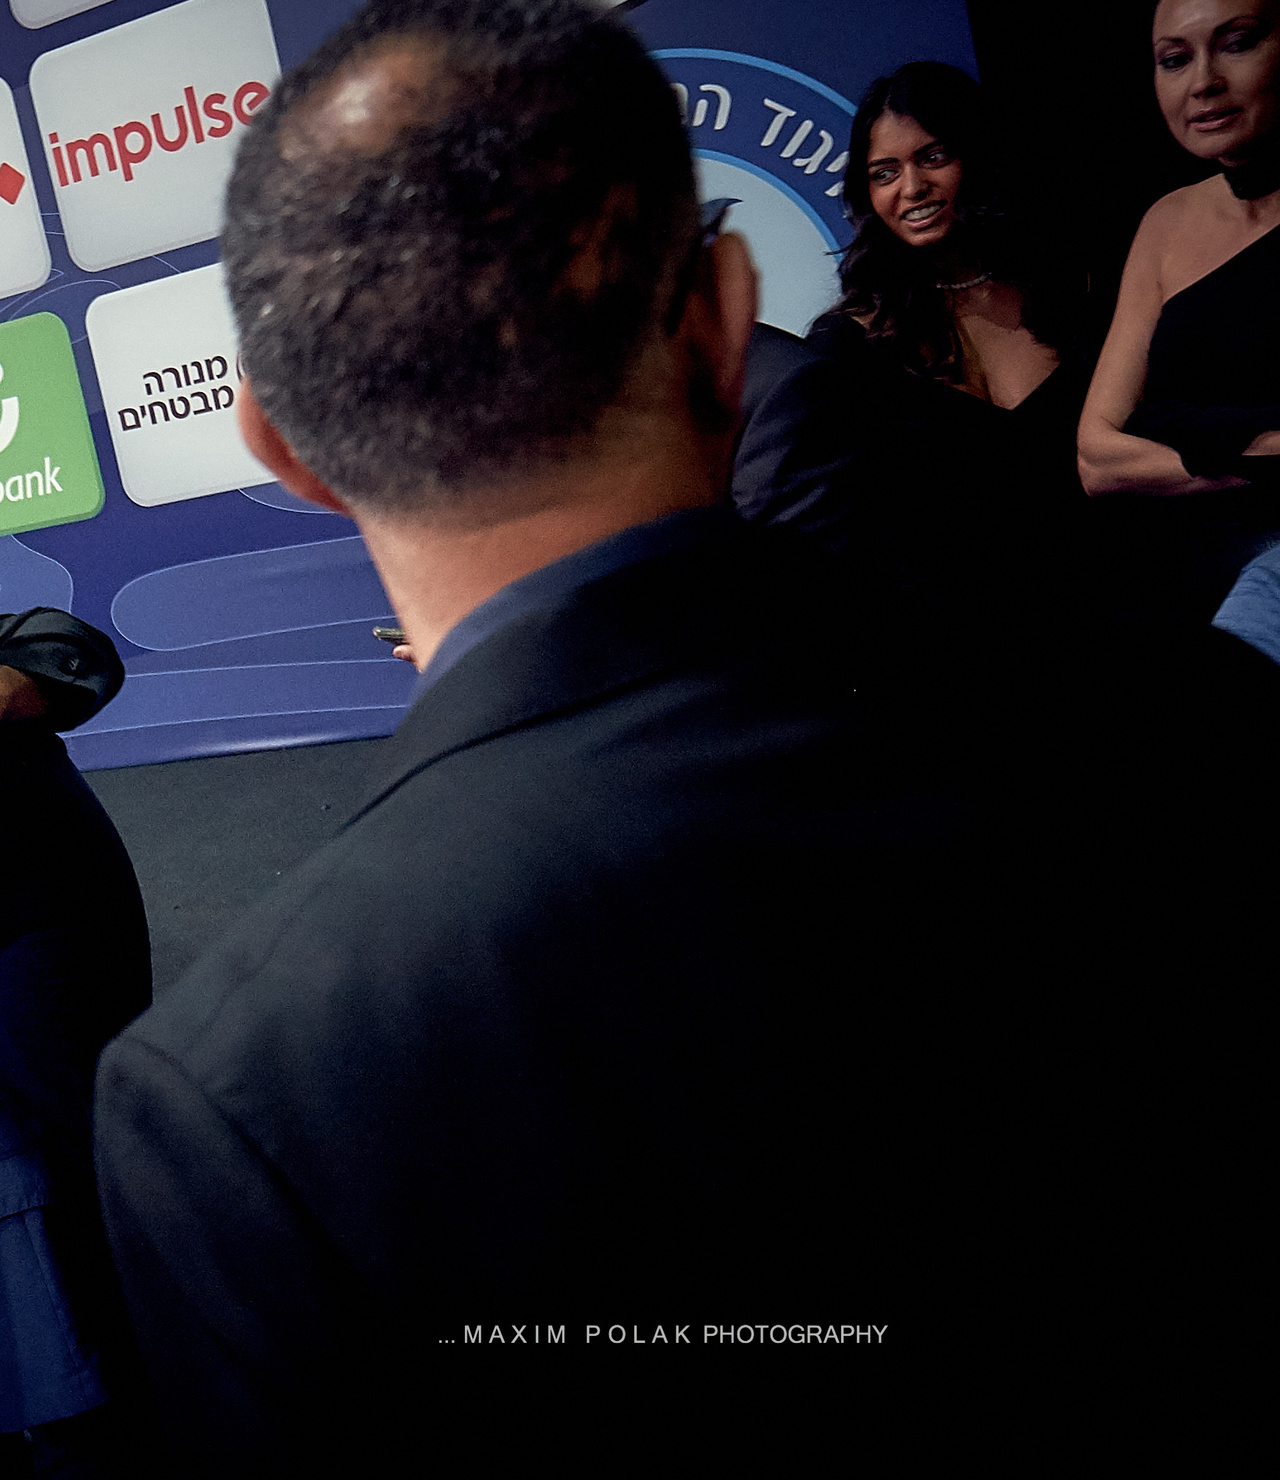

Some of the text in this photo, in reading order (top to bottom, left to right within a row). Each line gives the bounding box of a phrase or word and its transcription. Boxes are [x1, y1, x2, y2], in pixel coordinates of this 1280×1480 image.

[48, 81, 271, 188] impulse
[142, 354, 229, 398] מנורה
[118, 382, 235, 432] מבטחים
